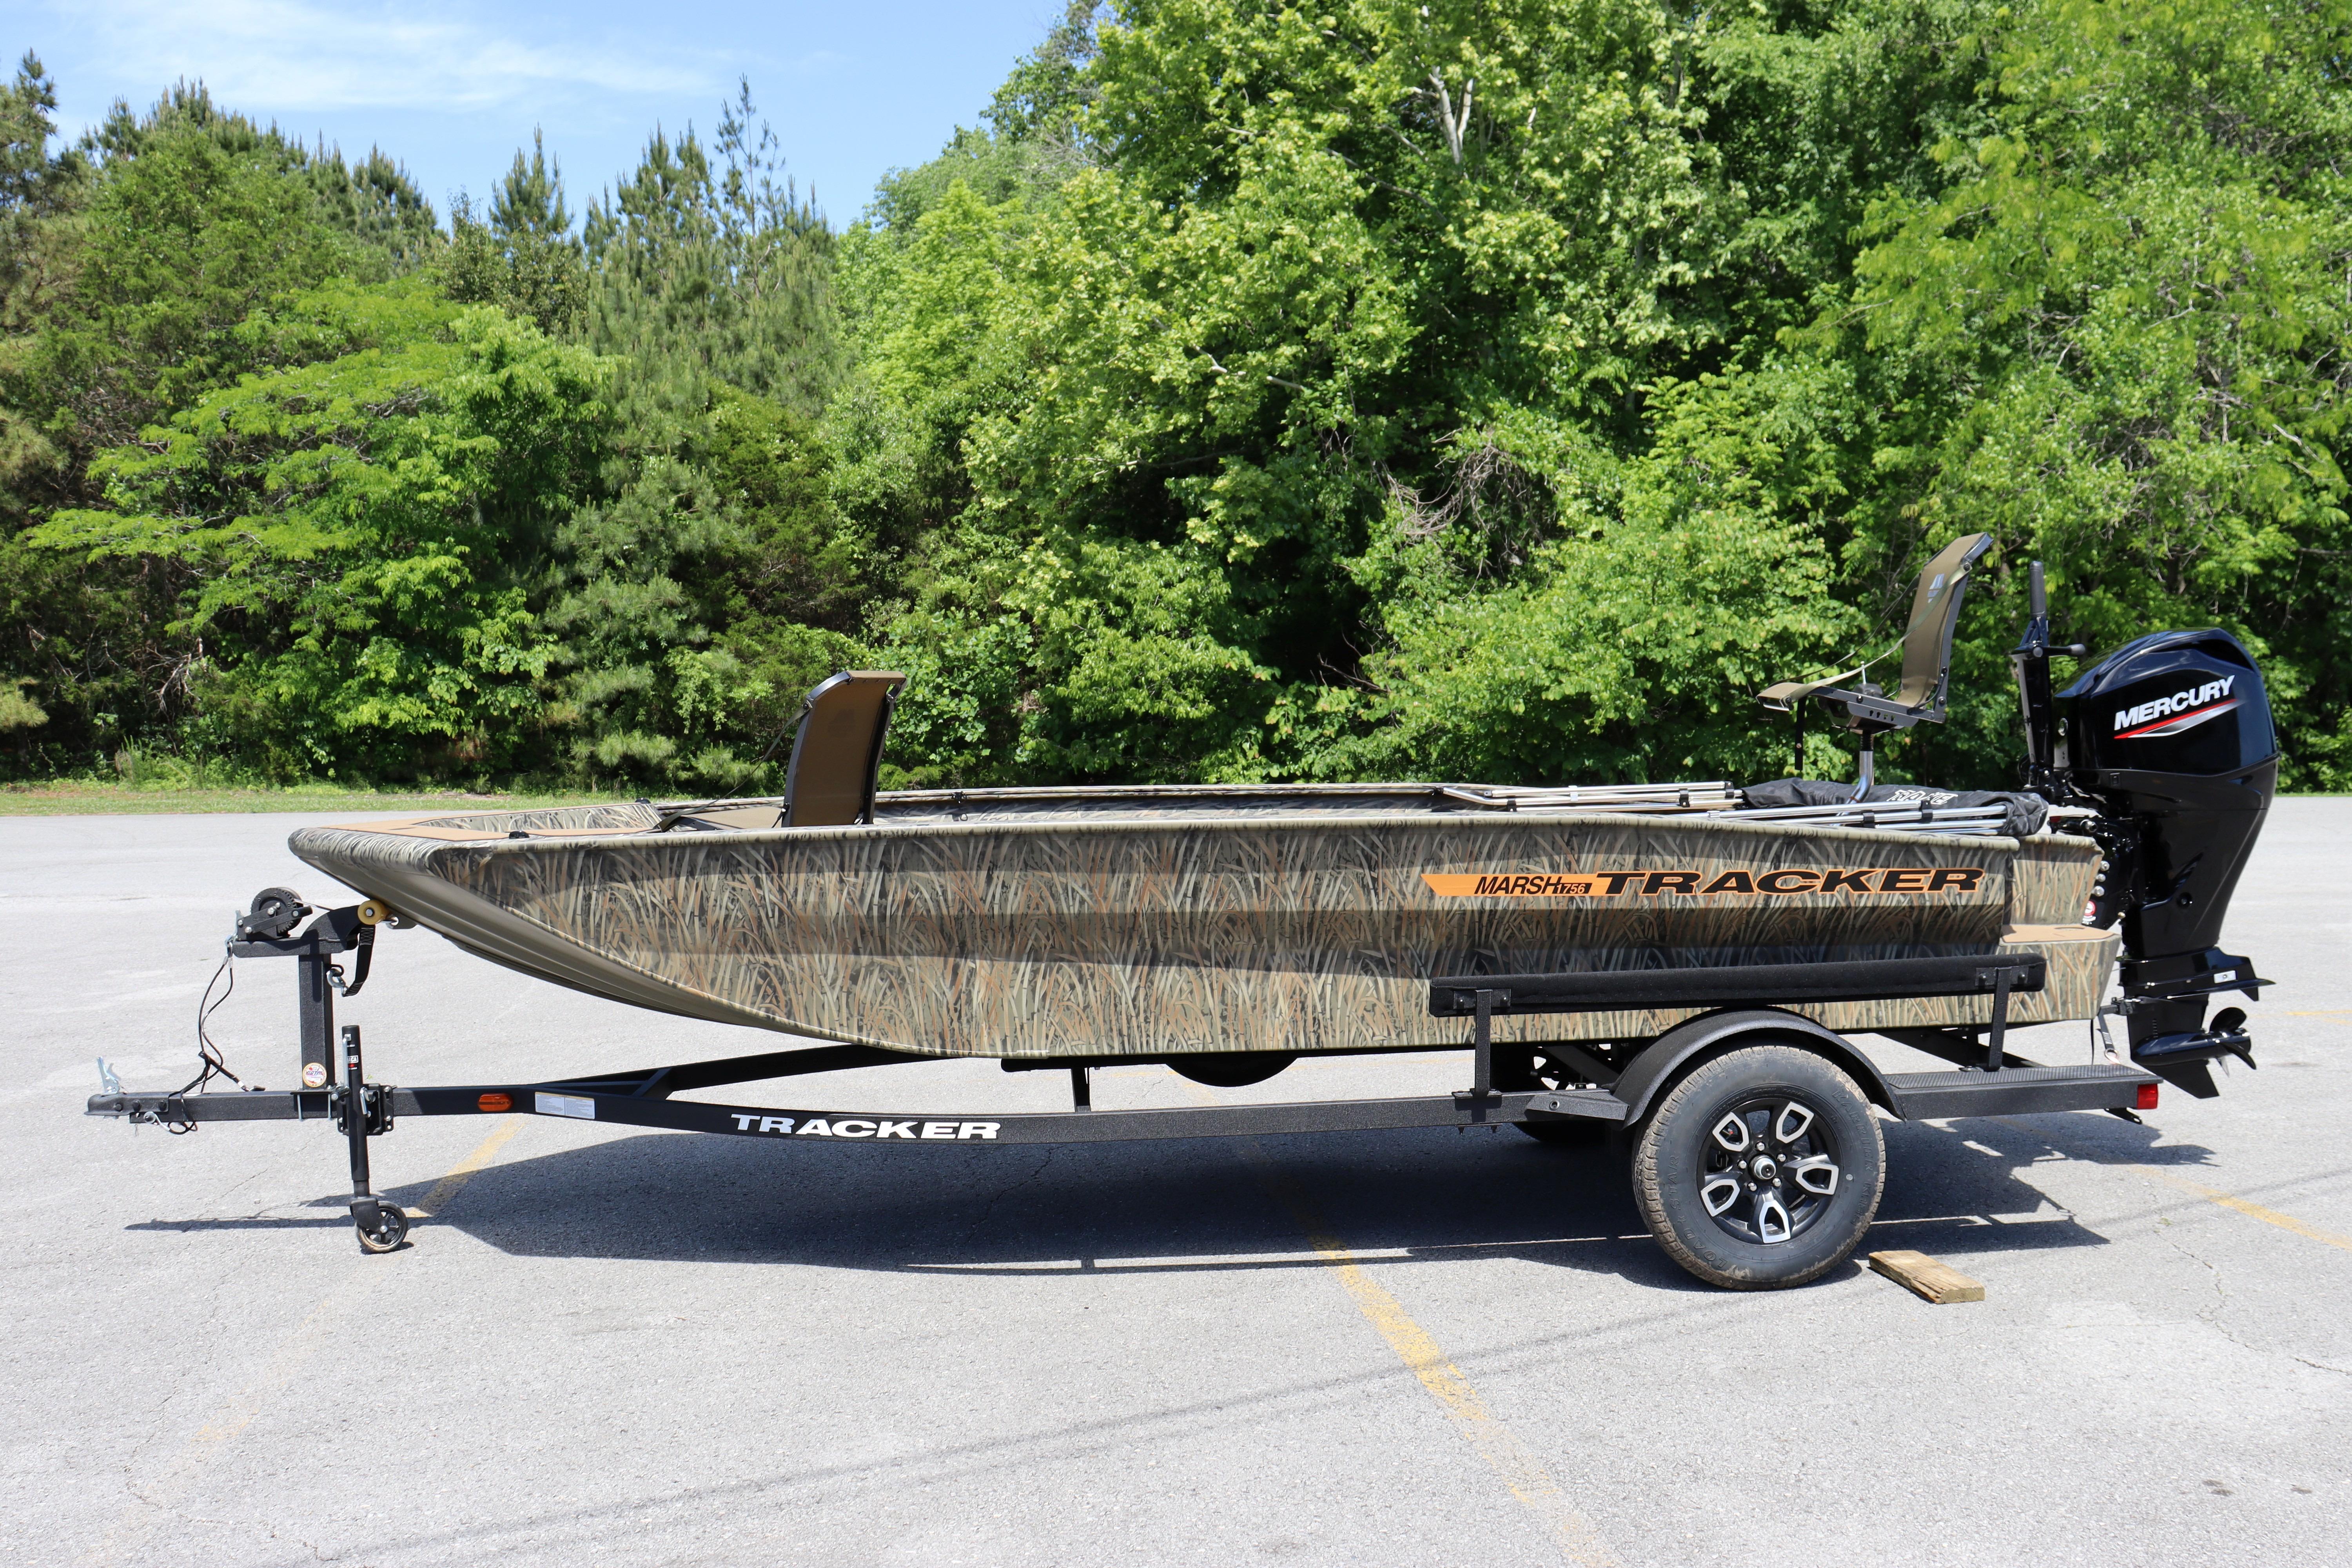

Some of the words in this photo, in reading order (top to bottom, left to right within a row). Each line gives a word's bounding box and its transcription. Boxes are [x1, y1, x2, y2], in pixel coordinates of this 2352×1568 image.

[2114, 675, 2235, 731] MERCURY
[1474, 876, 1563, 895] MARSH
[1556, 883, 1586, 894] 1756
[1596, 869, 1985, 895] TRACKER
[731, 1113, 1001, 1139] TRACKER
[1832, 1089, 1874, 1171] KARRIER
[1668, 1155, 1681, 1210] STAR
[1683, 1228, 1728, 1269] LOAD
